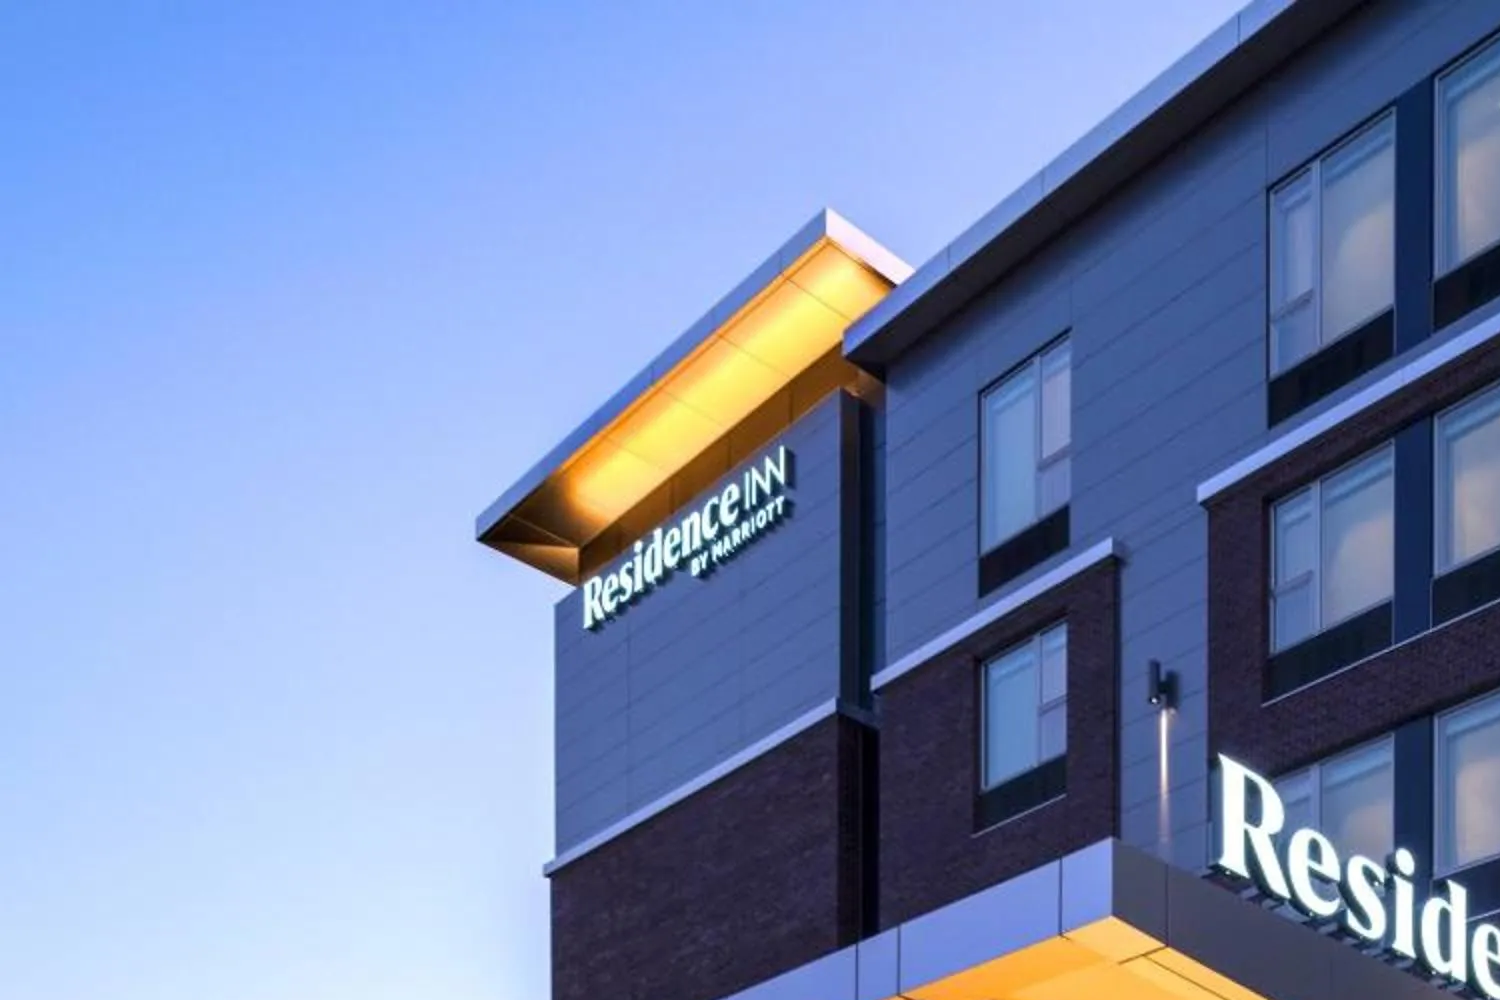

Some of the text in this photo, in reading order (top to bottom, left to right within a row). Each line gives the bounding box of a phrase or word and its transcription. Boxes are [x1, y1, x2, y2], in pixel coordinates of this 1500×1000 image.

[583, 445, 785, 628] Residence INN
[690, 495, 785, 577] BY MARRIOTT
